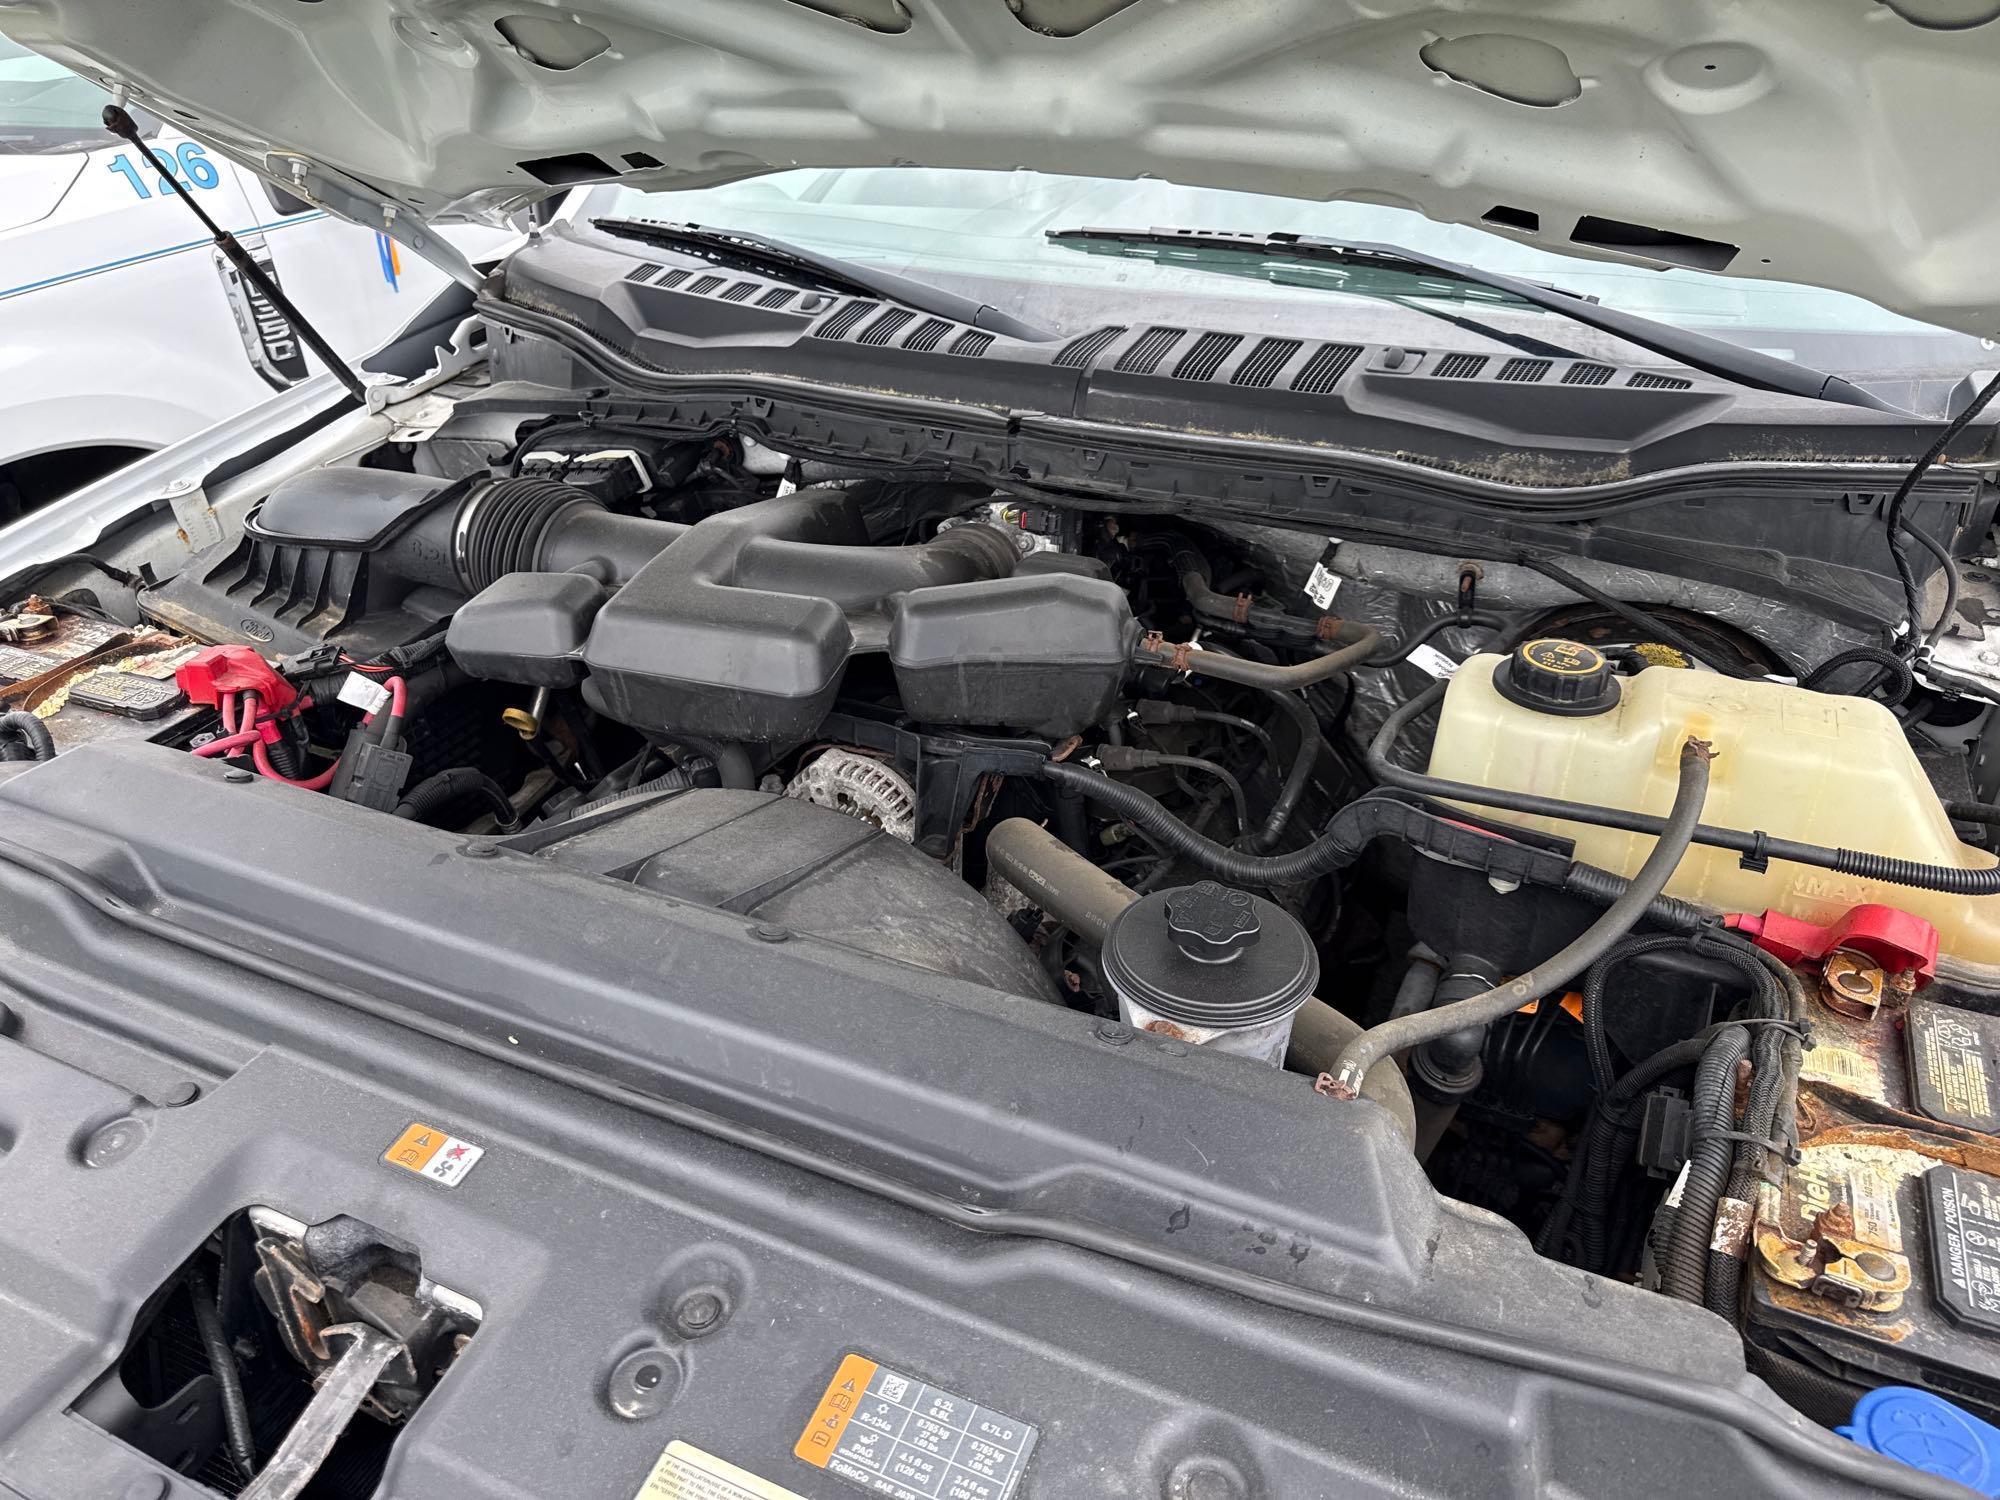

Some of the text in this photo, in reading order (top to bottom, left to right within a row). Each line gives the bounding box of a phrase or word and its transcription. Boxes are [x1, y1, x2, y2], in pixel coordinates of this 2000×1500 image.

[107, 142, 219, 199] 126
[1942, 1187, 1958, 1225] POISON
[1947, 1232, 1966, 1276] DANGER
[929, 1407, 950, 1421] 6.8L
[934, 1398, 954, 1413] 6.2L
[861, 1412, 892, 1431] R-134a
[980, 1421, 1013, 1440] 6.7L D
[938, 1426, 951, 1440] kg
[852, 1443, 874, 1459] PAG
[971, 1441, 1006, 1463] 0.765 kg
[899, 1452, 934, 1473] 4.1 fl oz
[829, 1459, 870, 1483] FoMoCo
[874, 1480, 895, 1493] SAE
[894, 1462, 930, 1485] (120 cc)
[953, 1475, 970, 1488] 3.4
[976, 1486, 990, 1496] oz
